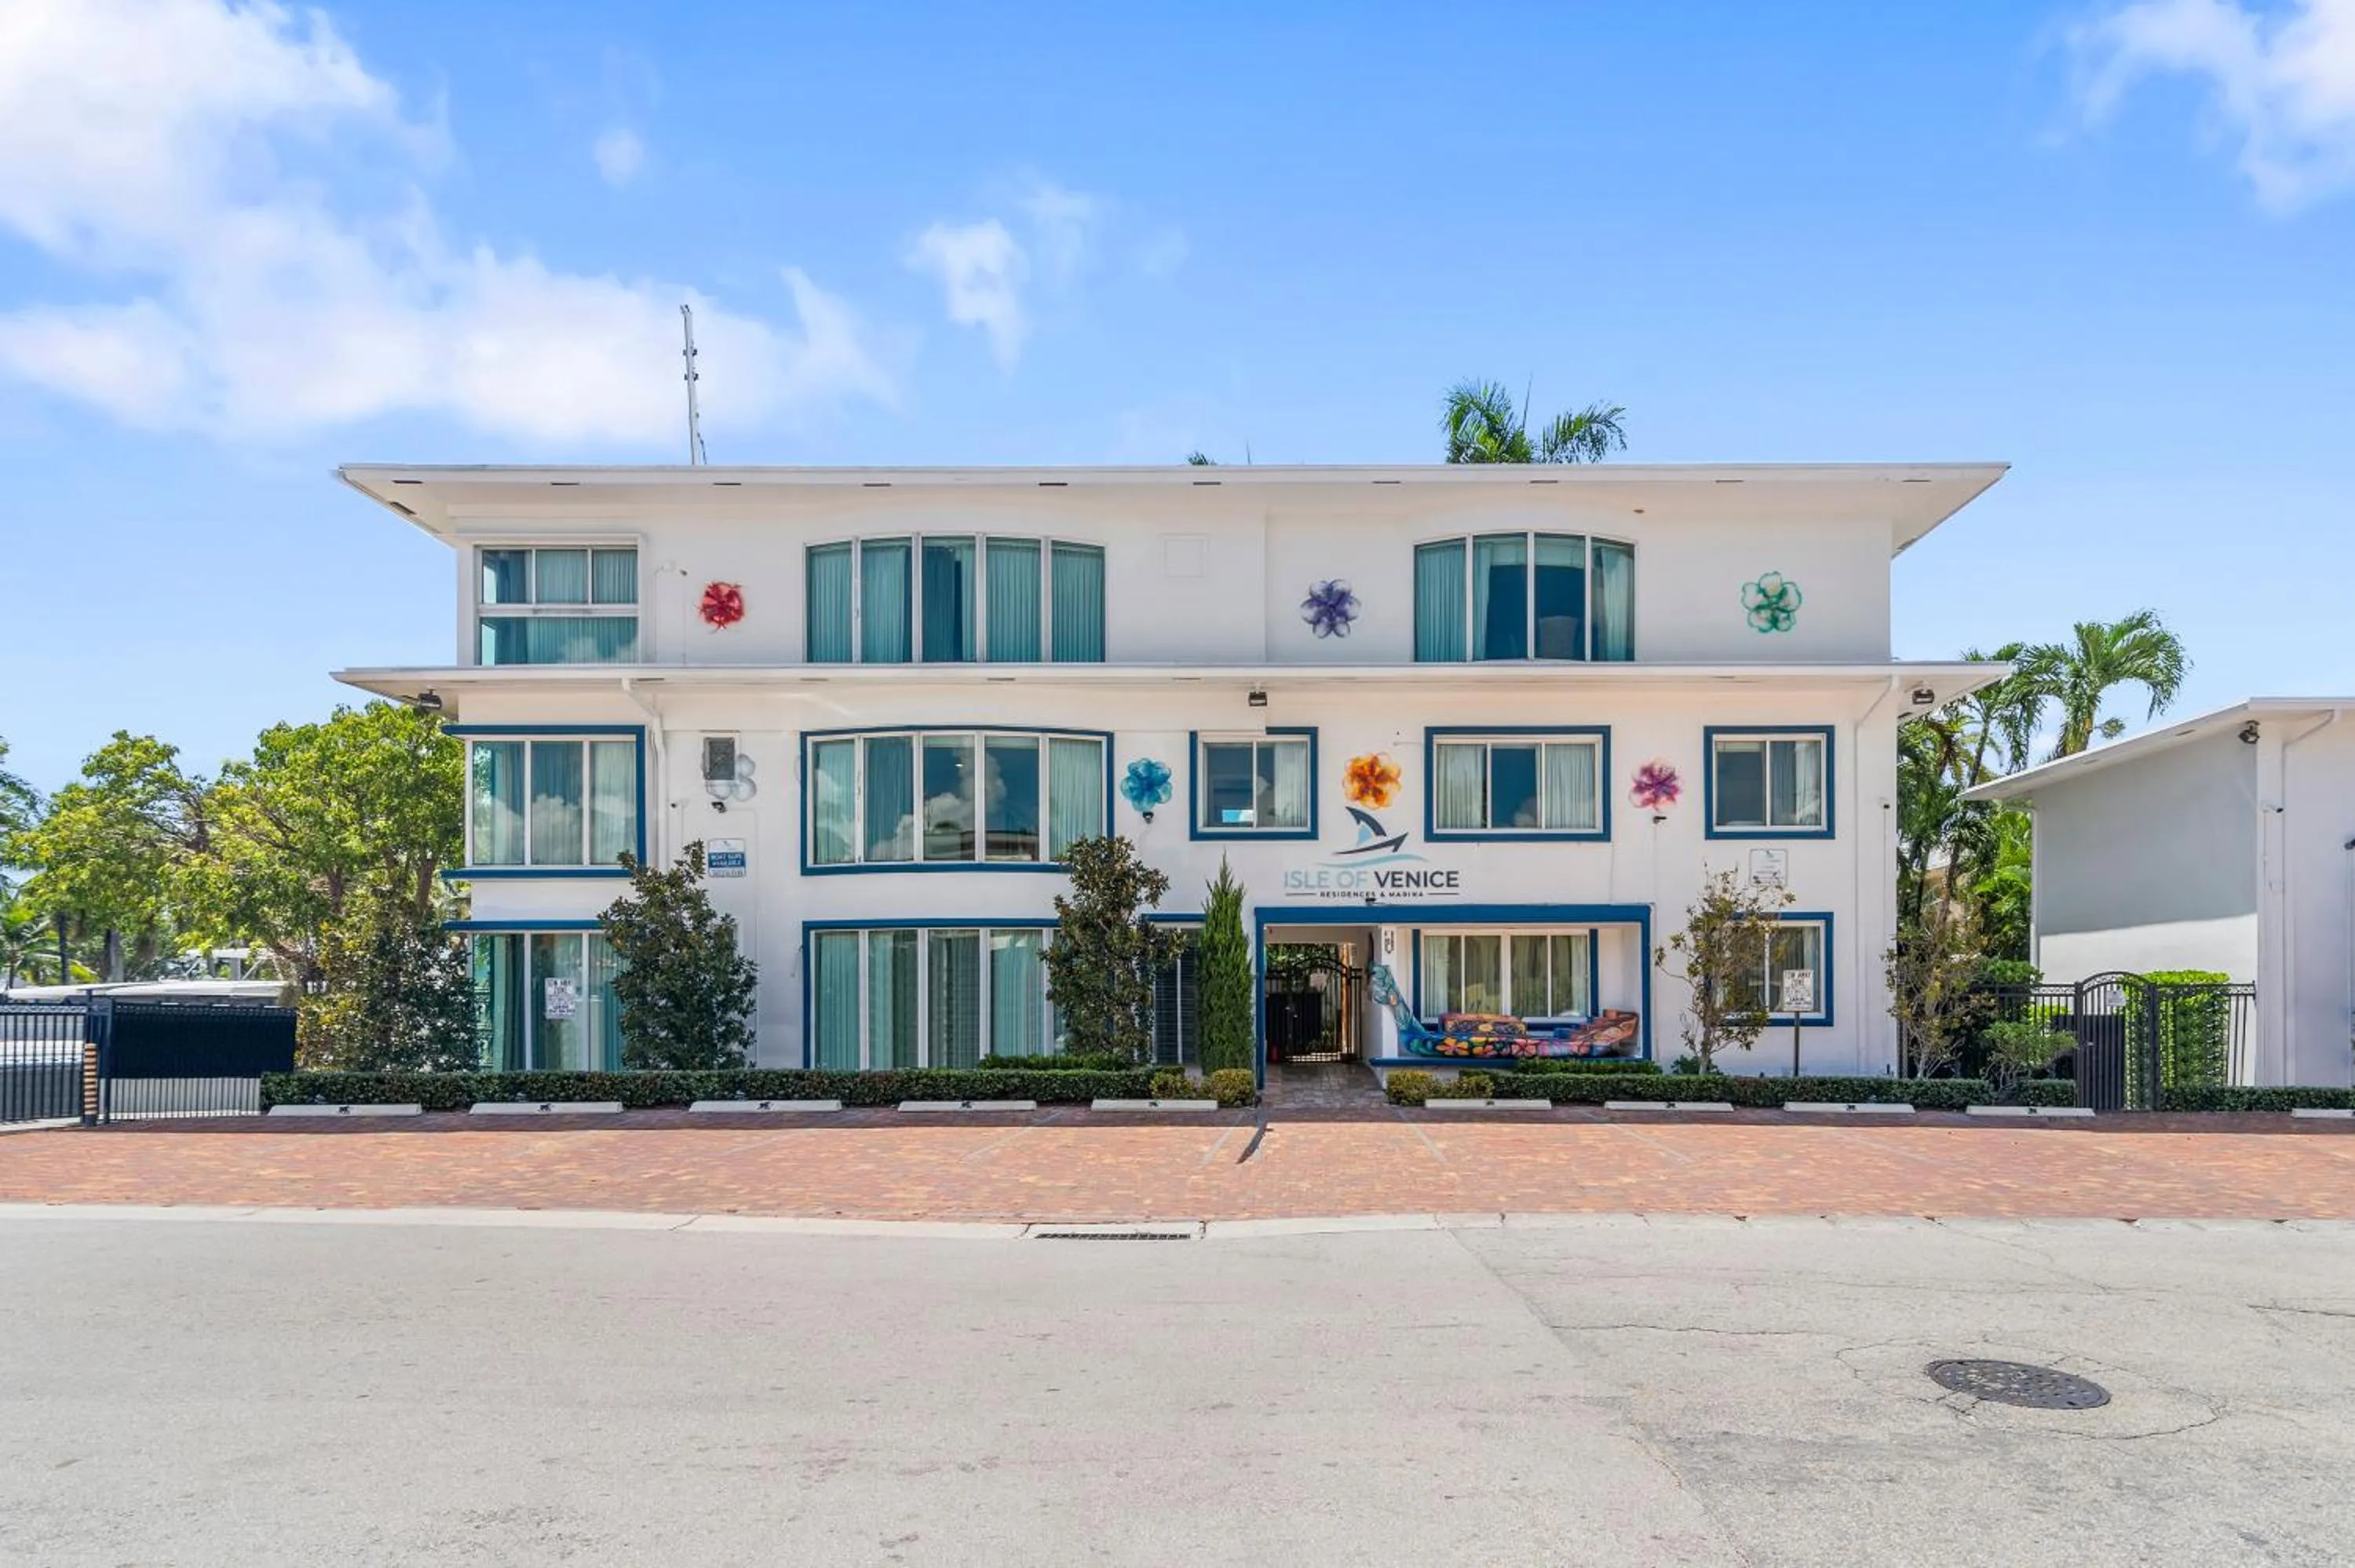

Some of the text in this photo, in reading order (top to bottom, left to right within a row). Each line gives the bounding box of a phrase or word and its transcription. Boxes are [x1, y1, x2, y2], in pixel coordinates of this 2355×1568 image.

[1283, 870, 1459, 888] ISLE OF VENICE
